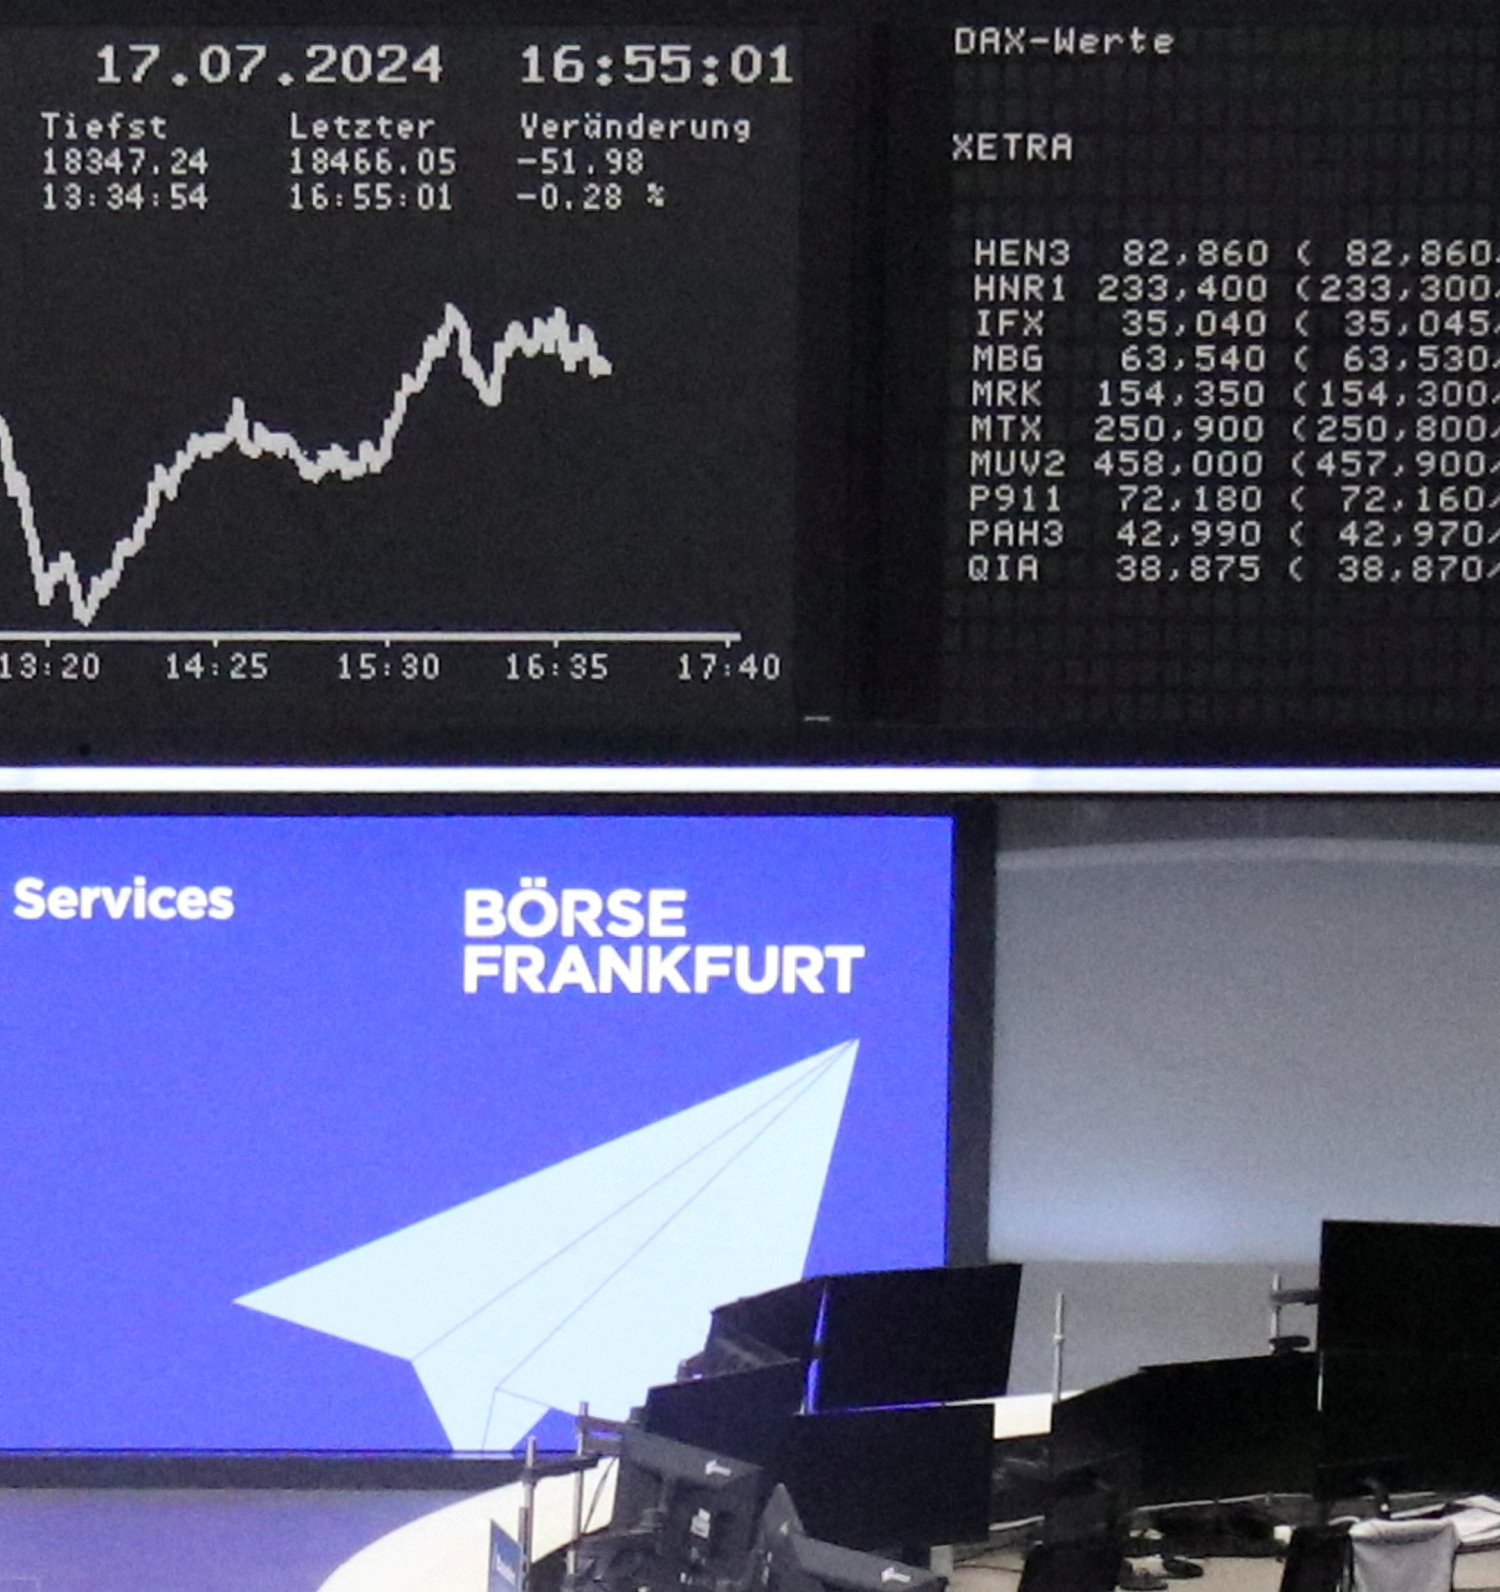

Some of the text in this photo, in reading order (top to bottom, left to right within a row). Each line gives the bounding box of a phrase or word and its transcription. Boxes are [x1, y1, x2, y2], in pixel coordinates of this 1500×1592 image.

[953, 25, 1176, 56] DAX-Werte
[96, 43, 444, 88] 17.07.2024
[521, 43, 794, 88] 16:55:01
[40, 110, 167, 141] Tiefst
[289, 111, 436, 141] Letzter
[519, 111, 751, 144] Veränderung
[43, 146, 209, 176] 18347.24
[289, 146, 457, 176] 18466.05
[516, 146, 644, 176] -51.98
[951, 131, 1074, 162] XETRA
[43, 181, 209, 211] 13:34:54
[290, 181, 453, 211] 16:55:01
[516, 181, 623, 211] -0.28
[973, 237, 1071, 268] HEN3
[1122, 237, 1270, 268] 82,860
[973, 272, 1066, 303] HNR1
[1096, 272, 1268, 303] 233,400
[976, 307, 1045, 338] IFX
[1121, 307, 1268, 338] 35,040
[971, 343, 1044, 373] MBG
[1120, 343, 1267, 373] 63,540
[971, 378, 1043, 408] MRK
[1097, 378, 1266, 409] 154,350
[970, 413, 1043, 443] MTX
[1093, 413, 1265, 444] 250,900
[969, 448, 1067, 478] MUV2
[1092, 448, 1264, 479] 458,000
[968, 482, 1062, 513] P911
[1117, 483, 1263, 514] 72,180
[968, 518, 1065, 548] PAH3
[1115, 518, 1262, 548] 42,990
[967, 553, 1039, 583] QIA
[1115, 553, 1261, 583] 38,875
[166, 651, 269, 680] 14:25
[338, 651, 440, 681] 15:30
[506, 651, 609, 681] 16:35
[678, 652, 781, 681] 17:40
[12, 874, 236, 922] Services
[462, 874, 689, 940] BÖRSE
[461, 942, 867, 996] FRANKFURT
